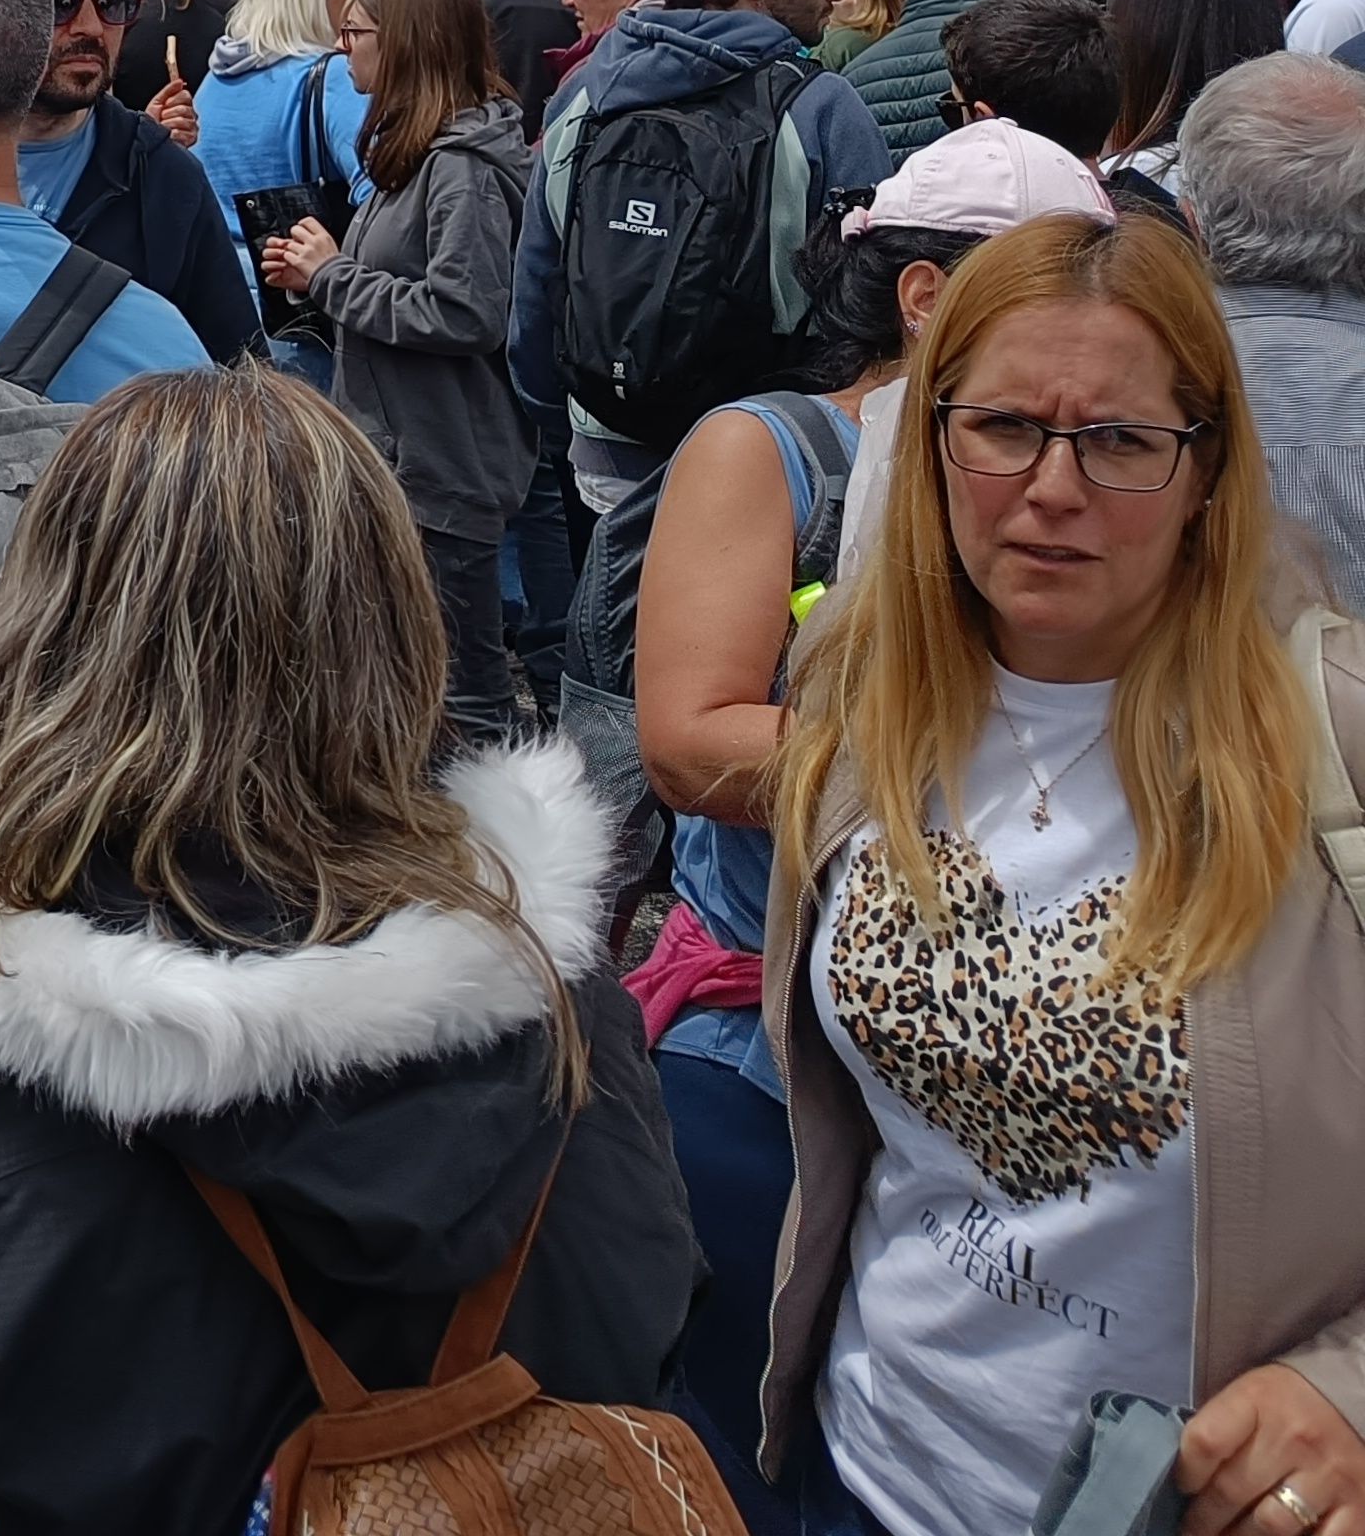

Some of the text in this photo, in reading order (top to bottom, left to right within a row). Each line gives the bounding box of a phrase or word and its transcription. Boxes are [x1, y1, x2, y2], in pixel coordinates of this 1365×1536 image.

[920, 1207, 1119, 1339] not PERFECT
[958, 1197, 1049, 1286] REAL
